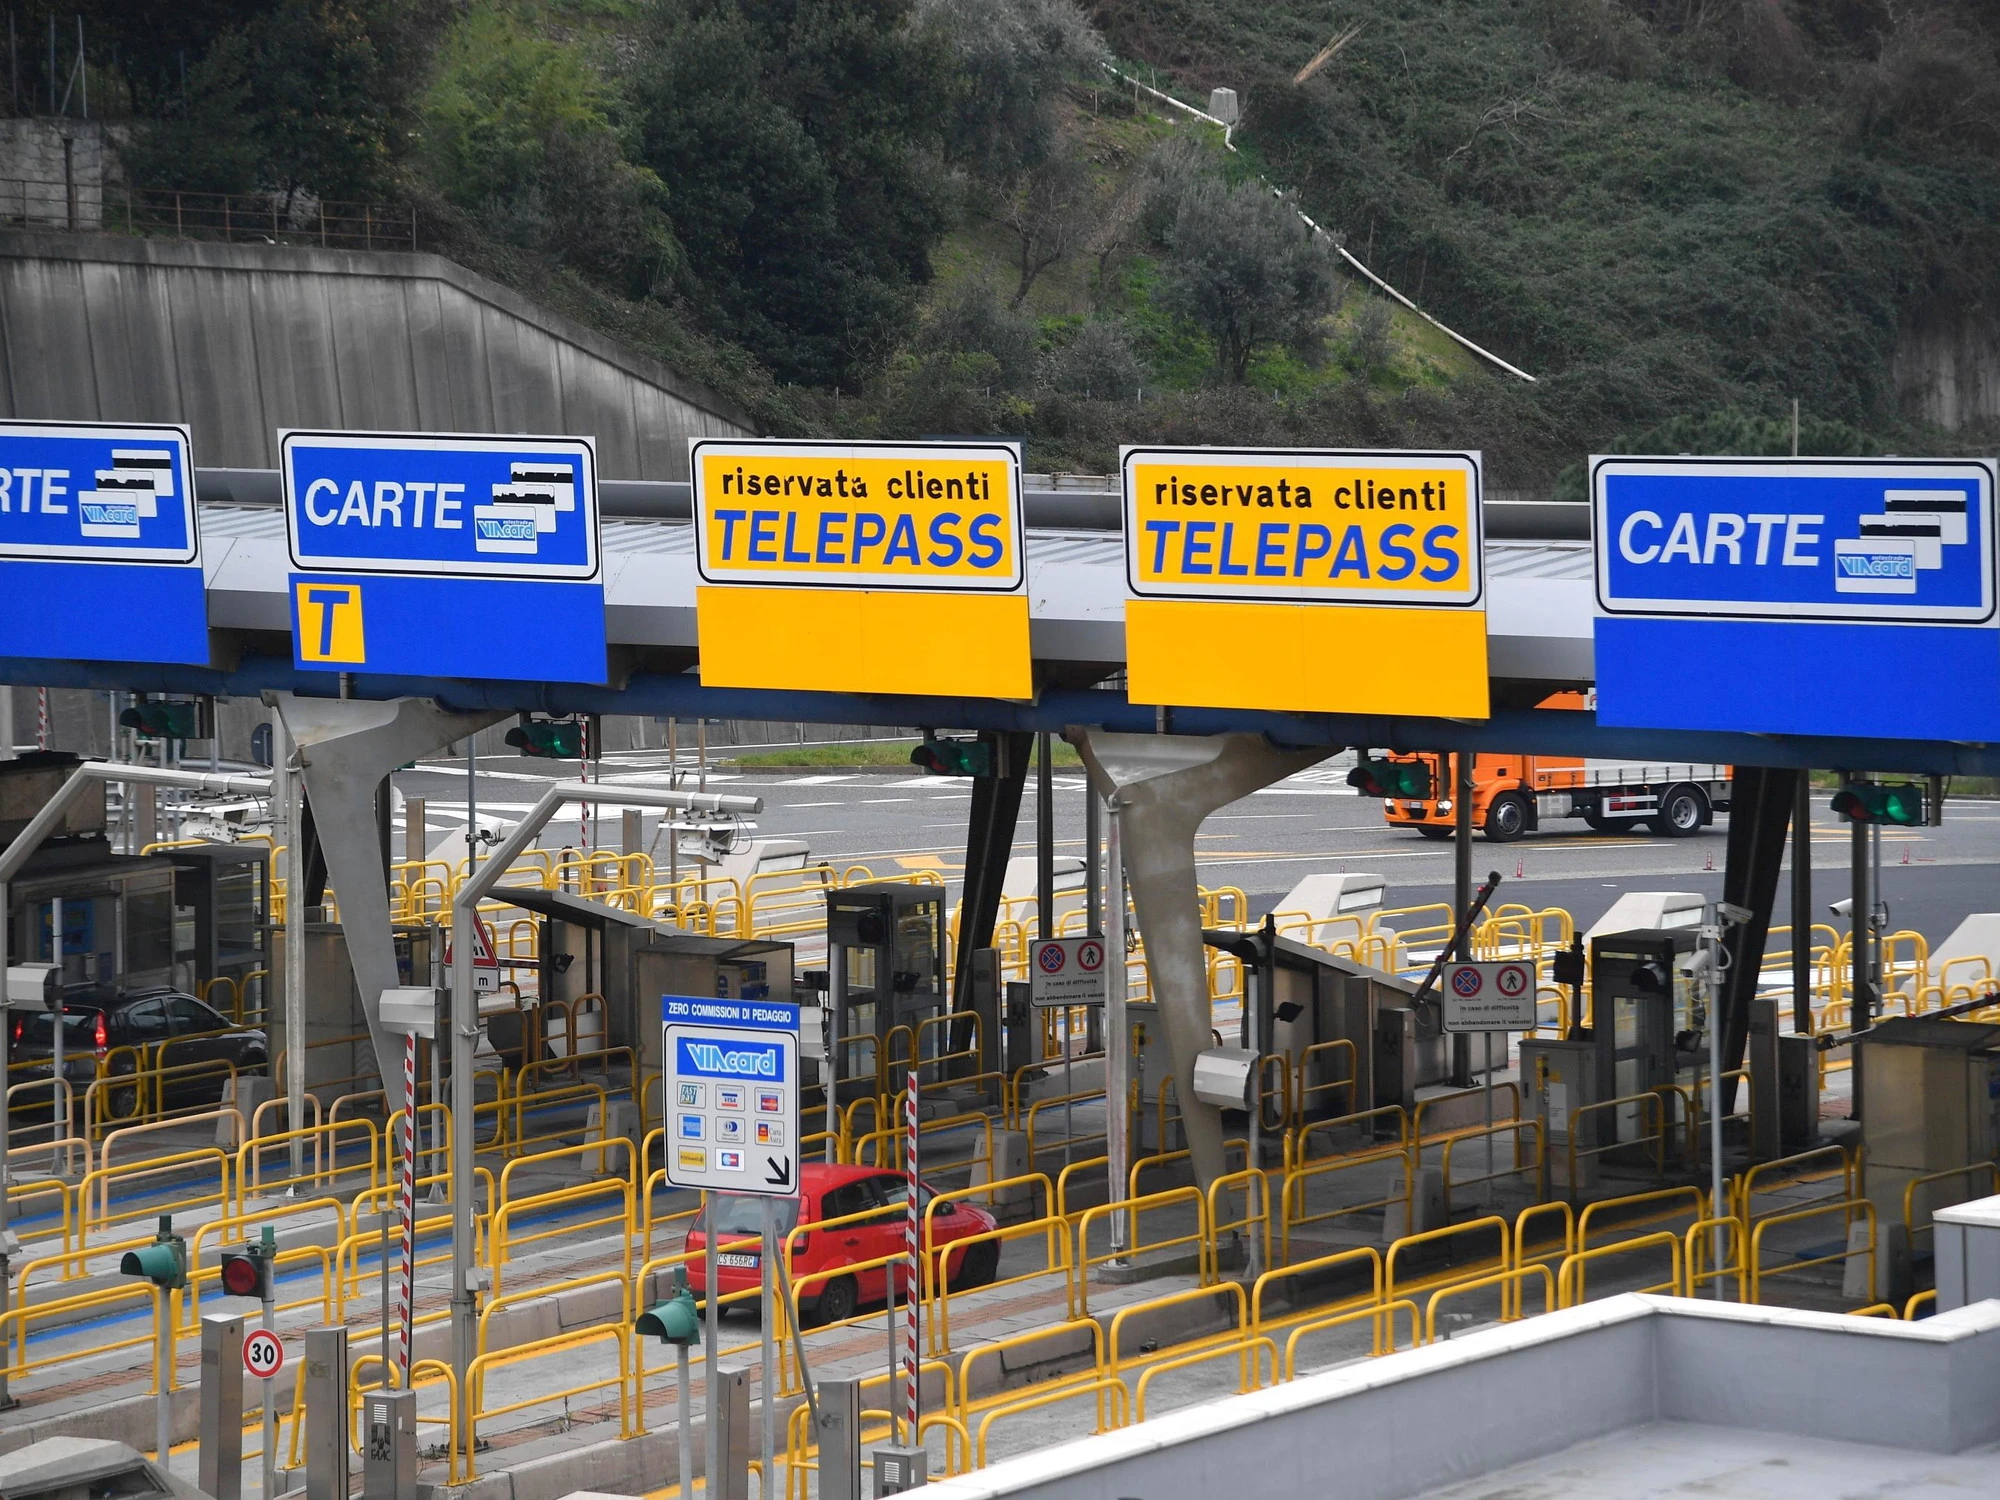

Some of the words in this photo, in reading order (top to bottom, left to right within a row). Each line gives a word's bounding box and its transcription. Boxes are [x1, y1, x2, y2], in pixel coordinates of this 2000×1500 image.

[722, 467, 868, 499] riservata
[887, 470, 990, 501] clienti
[1155, 476, 1312, 508] riservata
[1334, 479, 1447, 511] clienti
[81, 505, 137, 523] VIAcard
[304, 478, 466, 529] CARTE
[477, 520, 535, 539] VIAcard
[714, 509, 1004, 569] TELEPASS
[1618, 510, 1826, 567] CARTE
[1145, 520, 1460, 583] TELEPASS
[1837, 556, 1912, 577] VIAcard
[308, 589, 350, 656] T
[478, 976, 488, 986] m
[668, 1002, 689, 1015] ZERO
[691, 1005, 740, 1020] COMMISSIONI
[742, 1008, 750, 1020] DI
[752, 1008, 792, 1023] PEDAGGIO
[685, 1043, 776, 1076] VIAcard
[682, 1086, 697, 1095] FAST
[718, 1254, 728, 1264] CS
[729, 1255, 753, 1266] 656RC
[252, 1342, 275, 1365] 30
[371, 1449, 391, 1462] FAAC
